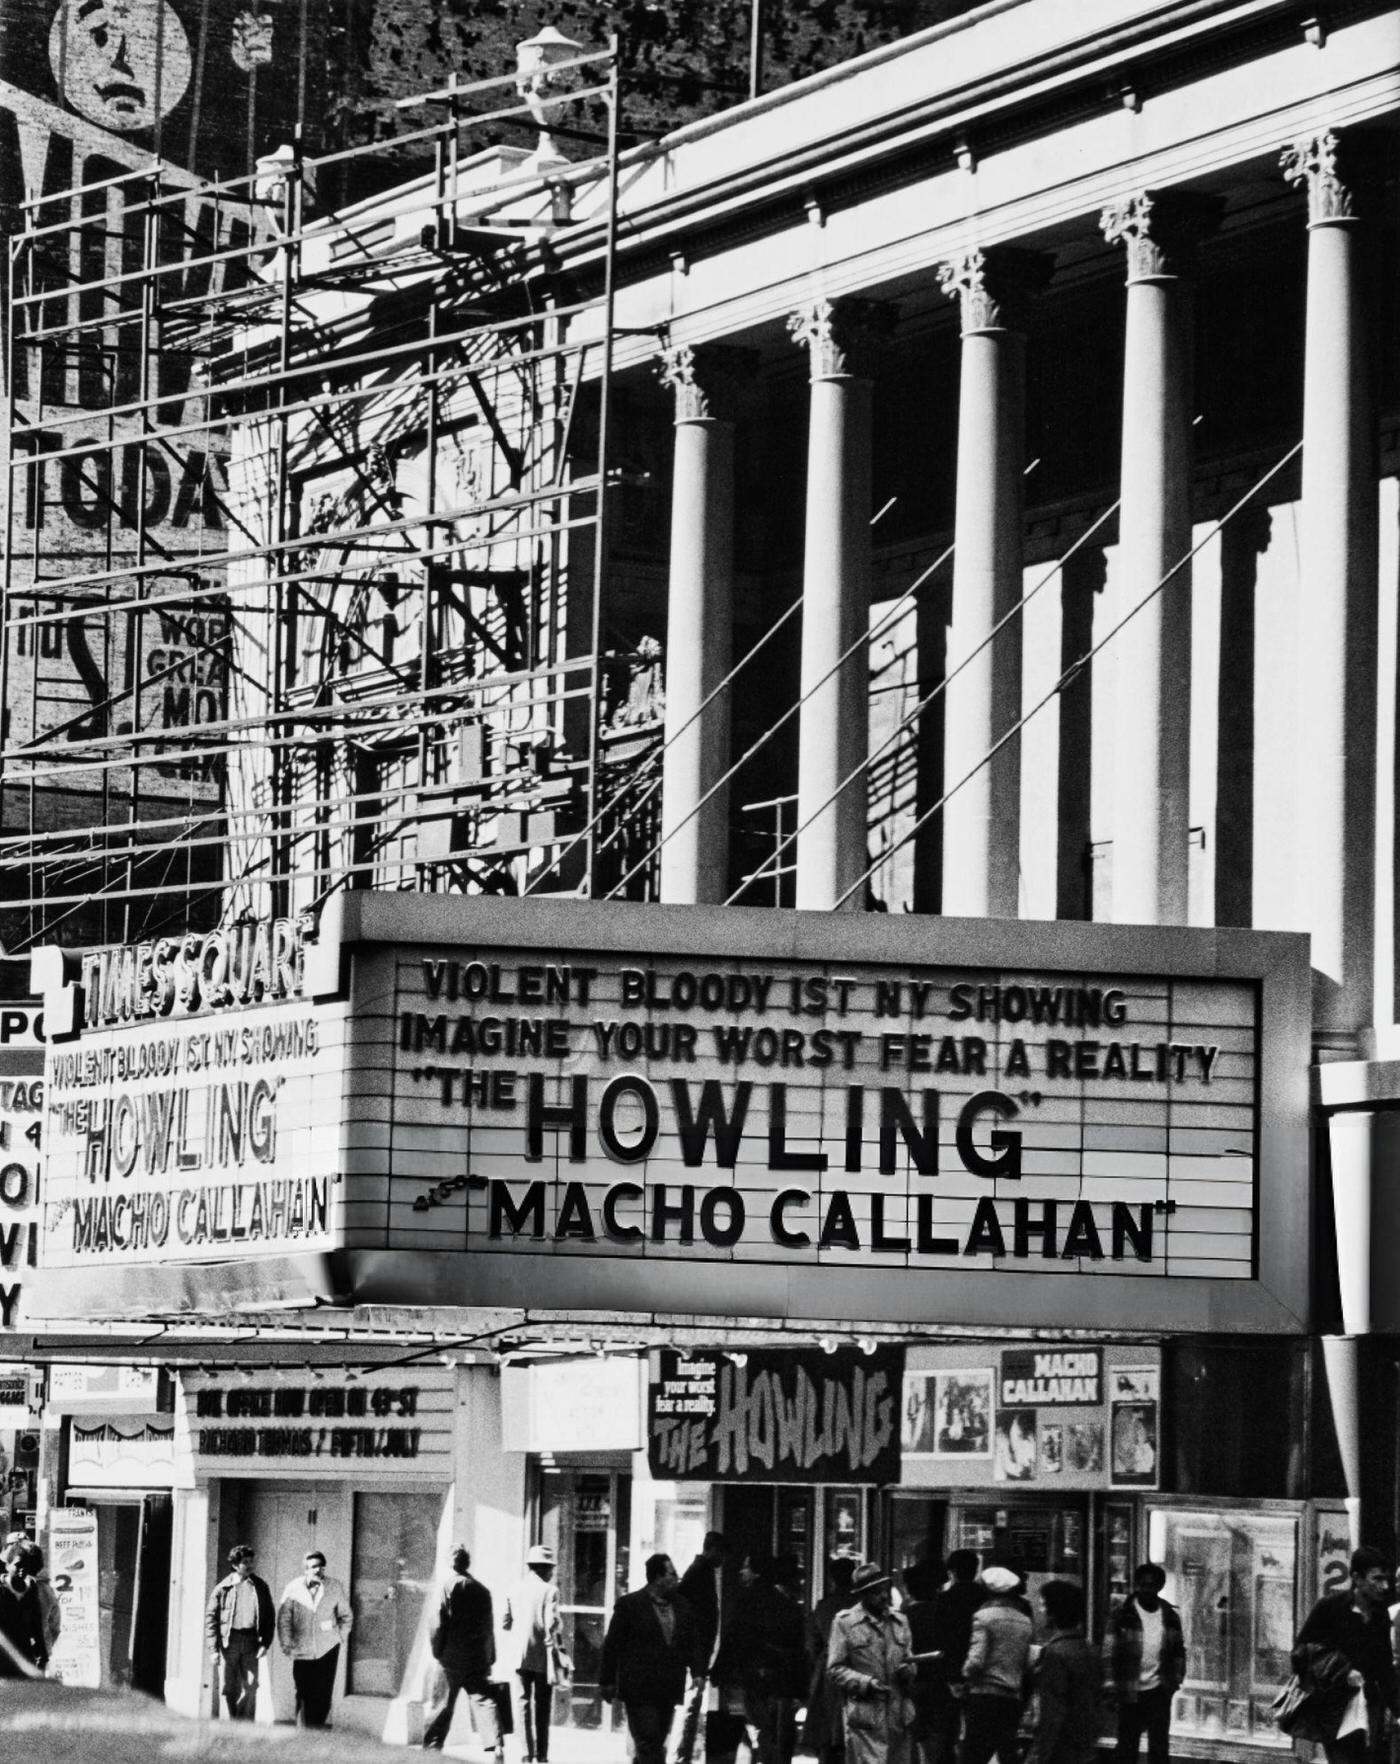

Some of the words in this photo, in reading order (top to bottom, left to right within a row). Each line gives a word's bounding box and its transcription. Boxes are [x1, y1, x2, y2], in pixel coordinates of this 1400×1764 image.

[163, 686, 226, 730] MO
[82, 937, 173, 1026] TIMES
[175, 910, 317, 1012] SQUARE
[424, 959, 598, 1007] VIOLENT
[621, 966, 774, 1014] BLOODY
[875, 977, 934, 1020] NY
[948, 982, 1127, 1028] SHOWING
[52, 1047, 117, 1090] VIOLENT
[118, 1038, 180, 1081] BLOODY
[240, 1018, 320, 1065] SHOWING
[401, 1012, 571, 1059] IMAGINE
[595, 1021, 699, 1064] YOUR
[715, 1025, 862, 1071] WORST
[880, 1030, 988, 1077] FEAR
[1005, 1037, 1031, 1079] A
[1046, 1040, 1219, 1085] REALITY
[72, 1194, 171, 1252] MACHO
[487, 1177, 747, 1248] MACHO
[664, 1381, 688, 1398] your
[677, 1357, 716, 1379] Imagine
[1002, 1377, 1099, 1404] CALLAHAN
[1033, 1352, 1099, 1379] MACHO
[653, 1416, 709, 1465] THE
[709, 1354, 895, 1475] HOWLING
